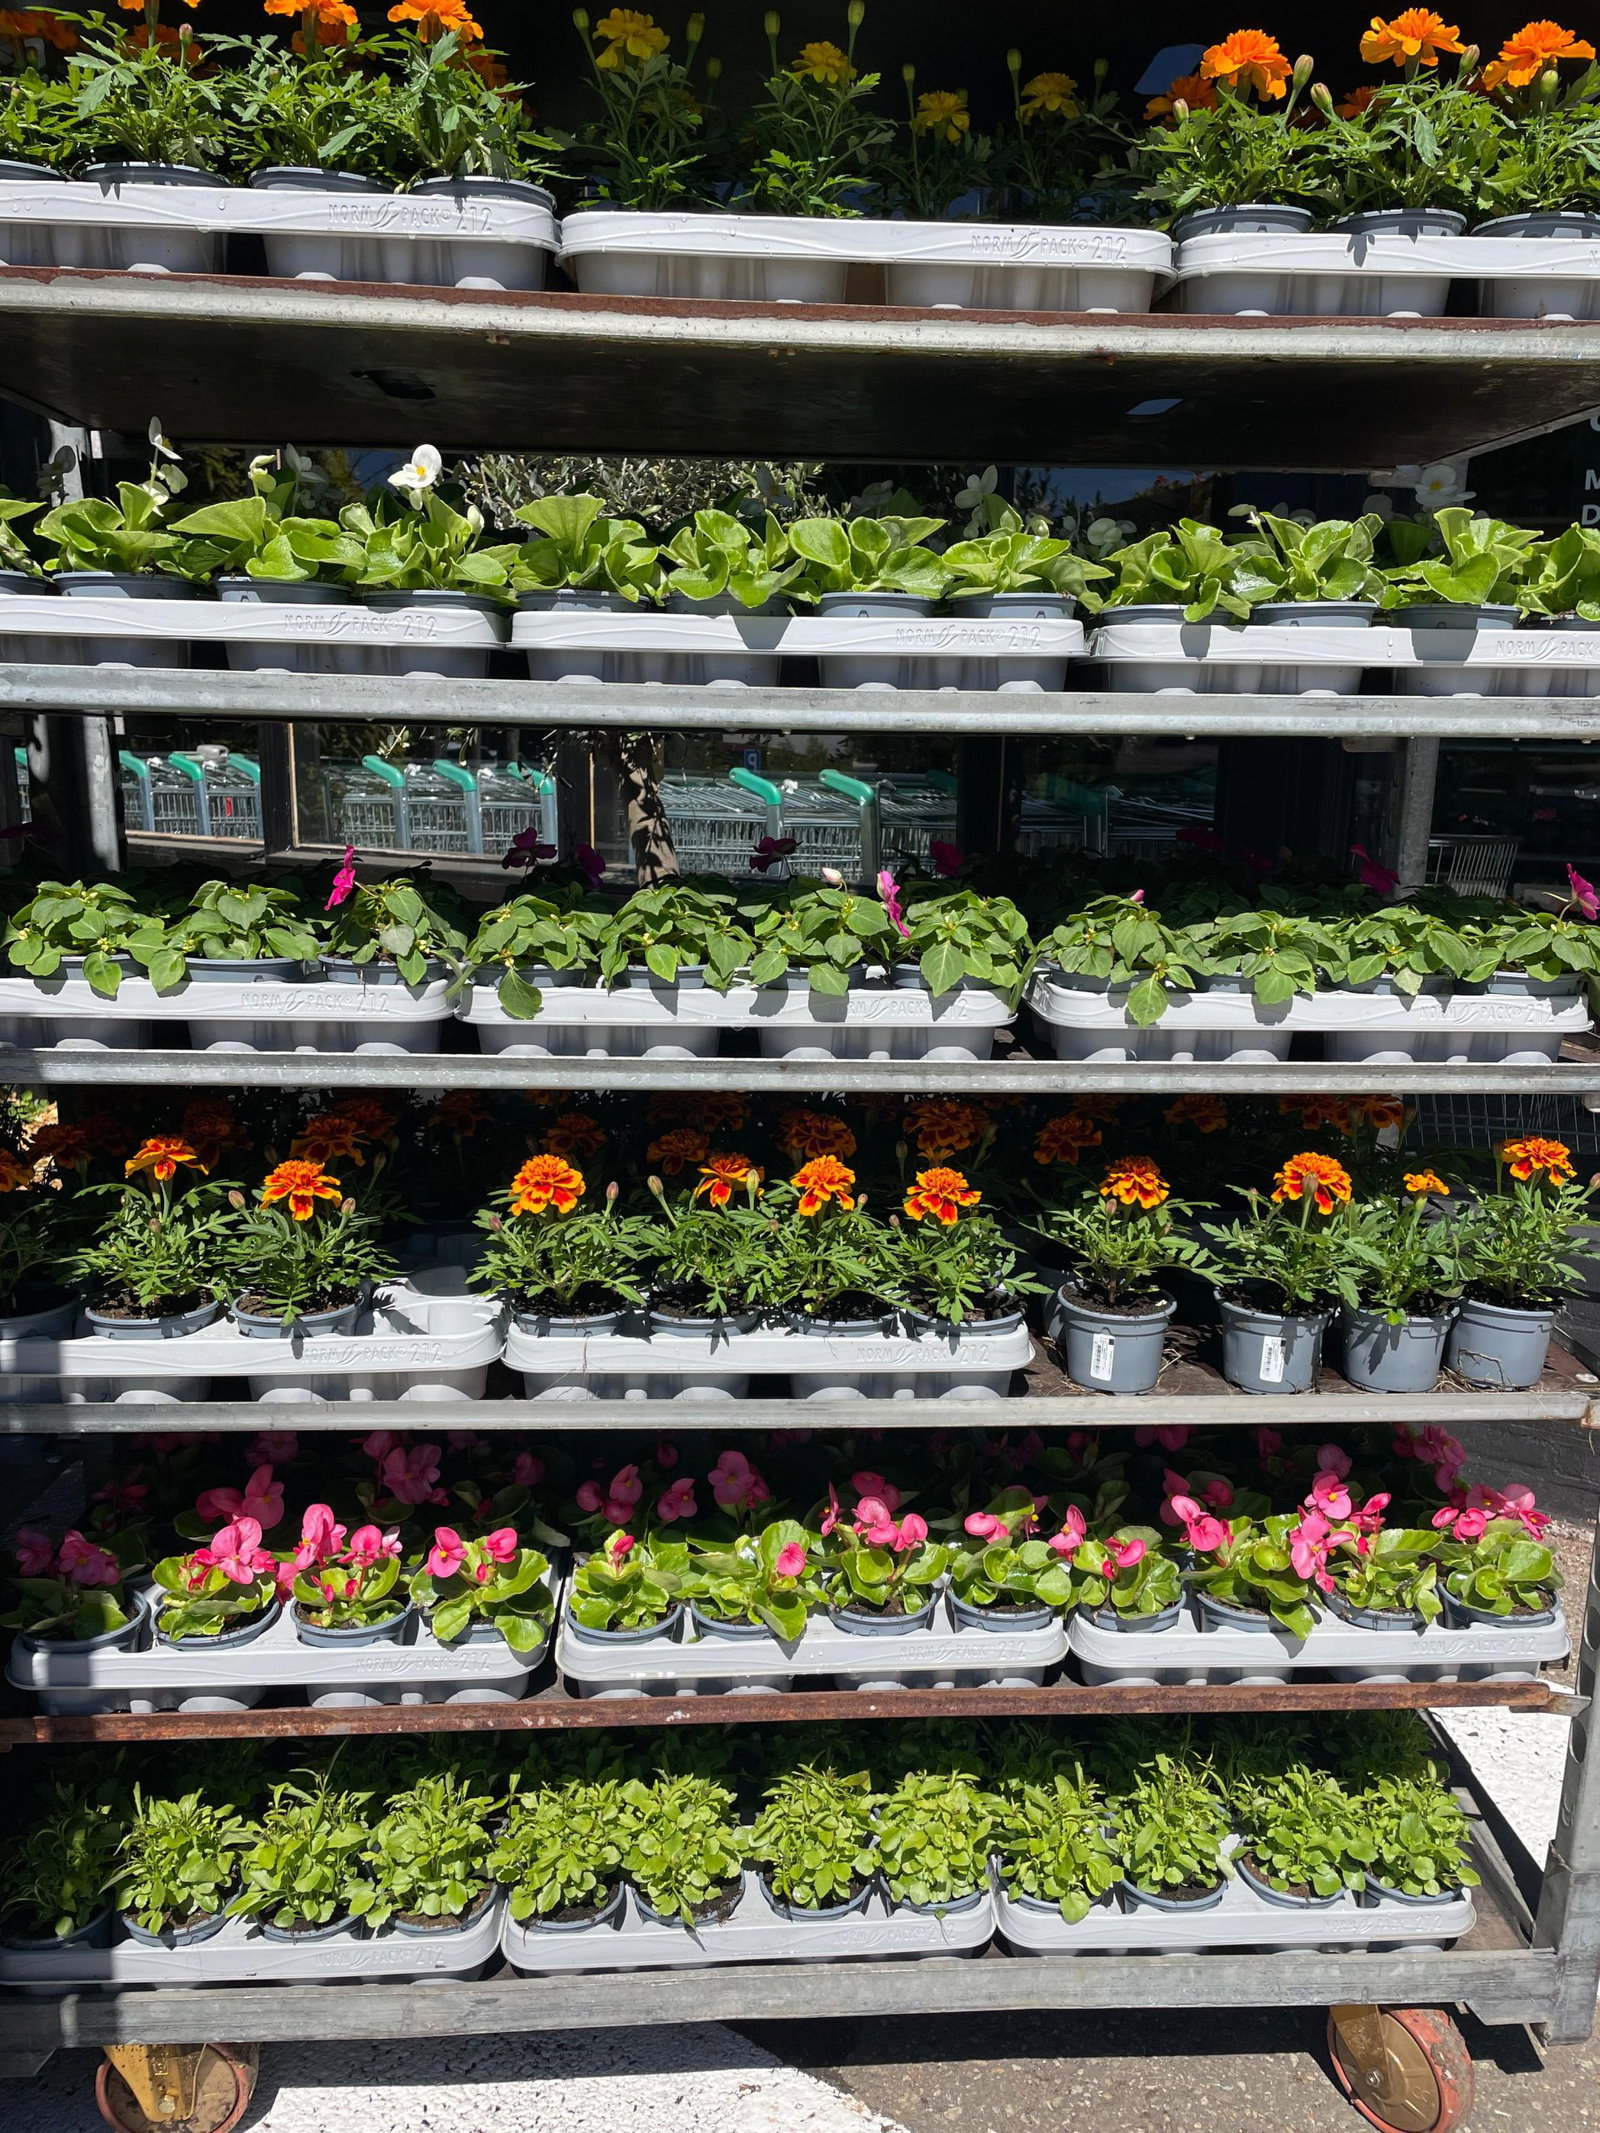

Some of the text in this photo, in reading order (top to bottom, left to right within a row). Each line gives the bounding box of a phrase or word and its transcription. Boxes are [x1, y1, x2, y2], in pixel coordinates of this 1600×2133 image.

[328, 203, 372, 225] NORM
[456, 206, 493, 233] 212
[971, 235, 1013, 256] NORM
[1092, 236, 1127, 260] 212
[284, 614, 325, 633] NORM
[403, 615, 438, 640] 212
[896, 628, 936, 646] NORM
[1008, 626, 1041, 649] 212
[1496, 640, 1535, 656] NORM
[241, 993, 281, 1010] NORM
[356, 993, 389, 1015] 212
[1419, 1005, 1457, 1021] NORM
[1525, 1003, 1555, 1025] 212
[301, 1347, 338, 1364] NORM
[410, 1342, 442, 1364] 212
[857, 1347, 892, 1363] NORM
[960, 1343, 990, 1365] 212
[999, 1640, 1027, 1660] 212
[1508, 1636, 1536, 1655] 212
[357, 1657, 393, 1672] NORM
[460, 1652, 490, 1672] 212
[1416, 1914, 1442, 1932] 212
[315, 1951, 351, 1967] NORM
[415, 1945, 446, 1965] 212
